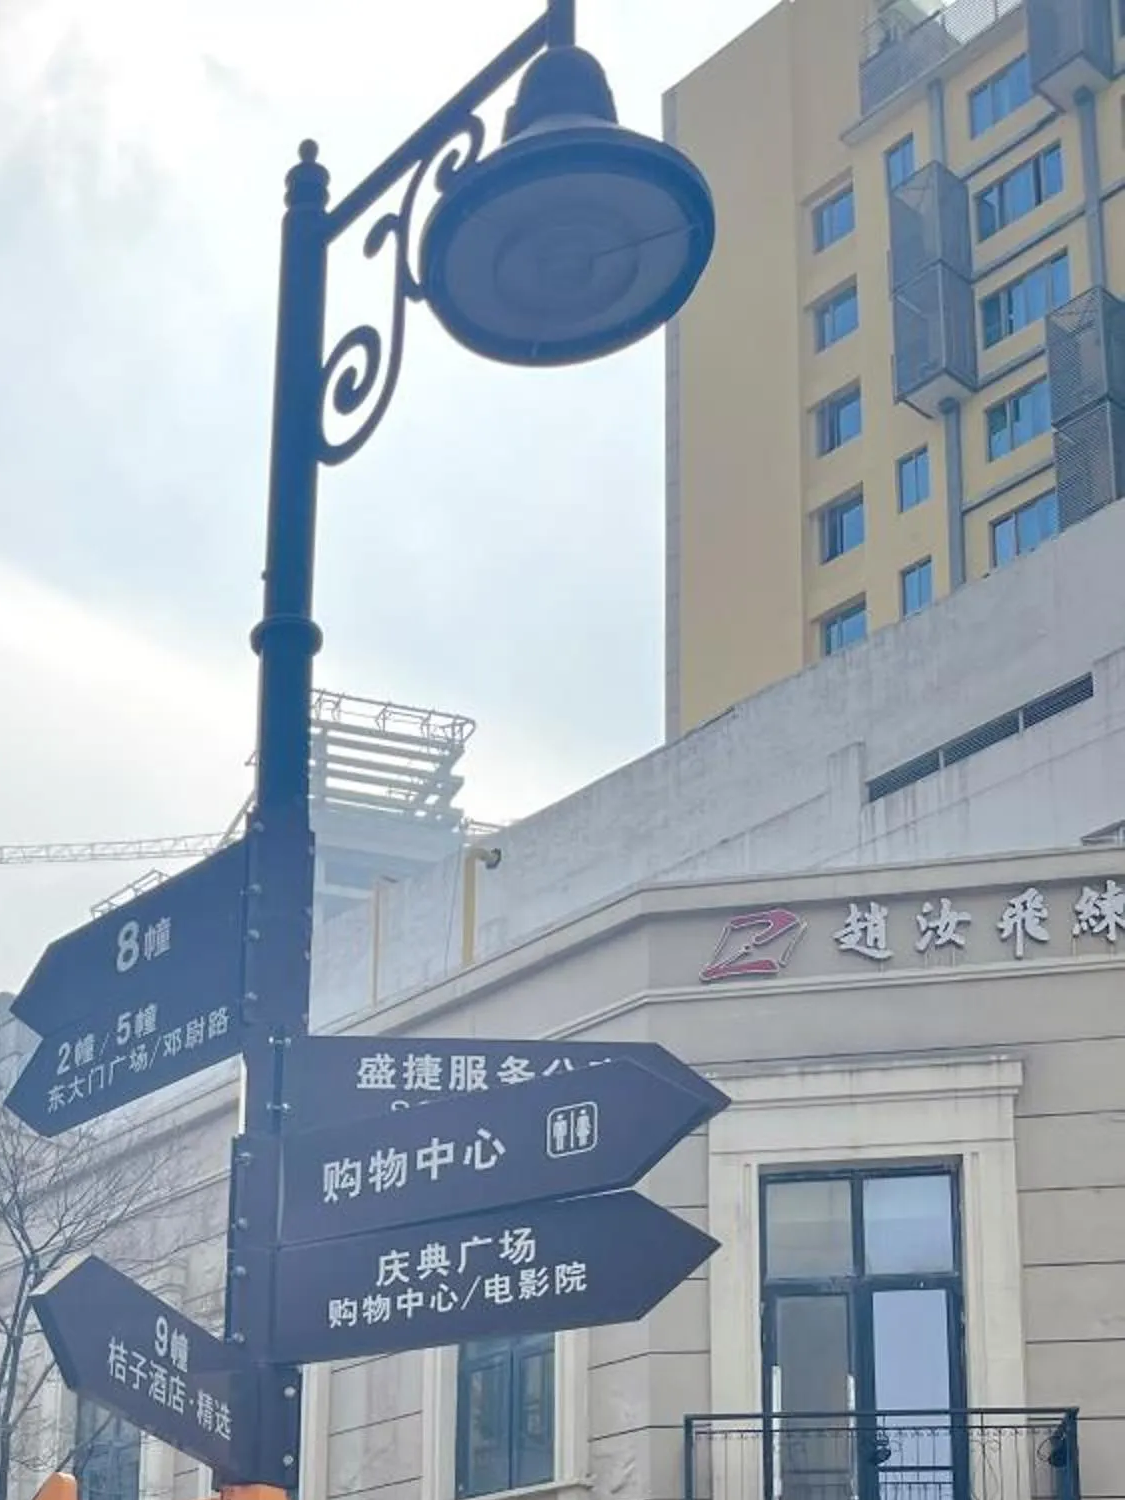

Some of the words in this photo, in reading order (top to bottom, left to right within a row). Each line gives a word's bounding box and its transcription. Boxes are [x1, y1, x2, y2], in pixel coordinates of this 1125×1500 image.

[115, 916, 173, 973] 8幢
[356, 1053, 612, 1092] 盛捷服务
[322, 1128, 506, 1203] 购物中心
[376, 1227, 537, 1287] 庆典广场
[327, 1262, 588, 1329] 购物中心/电影院
[153, 1315, 190, 1372] 9幢
